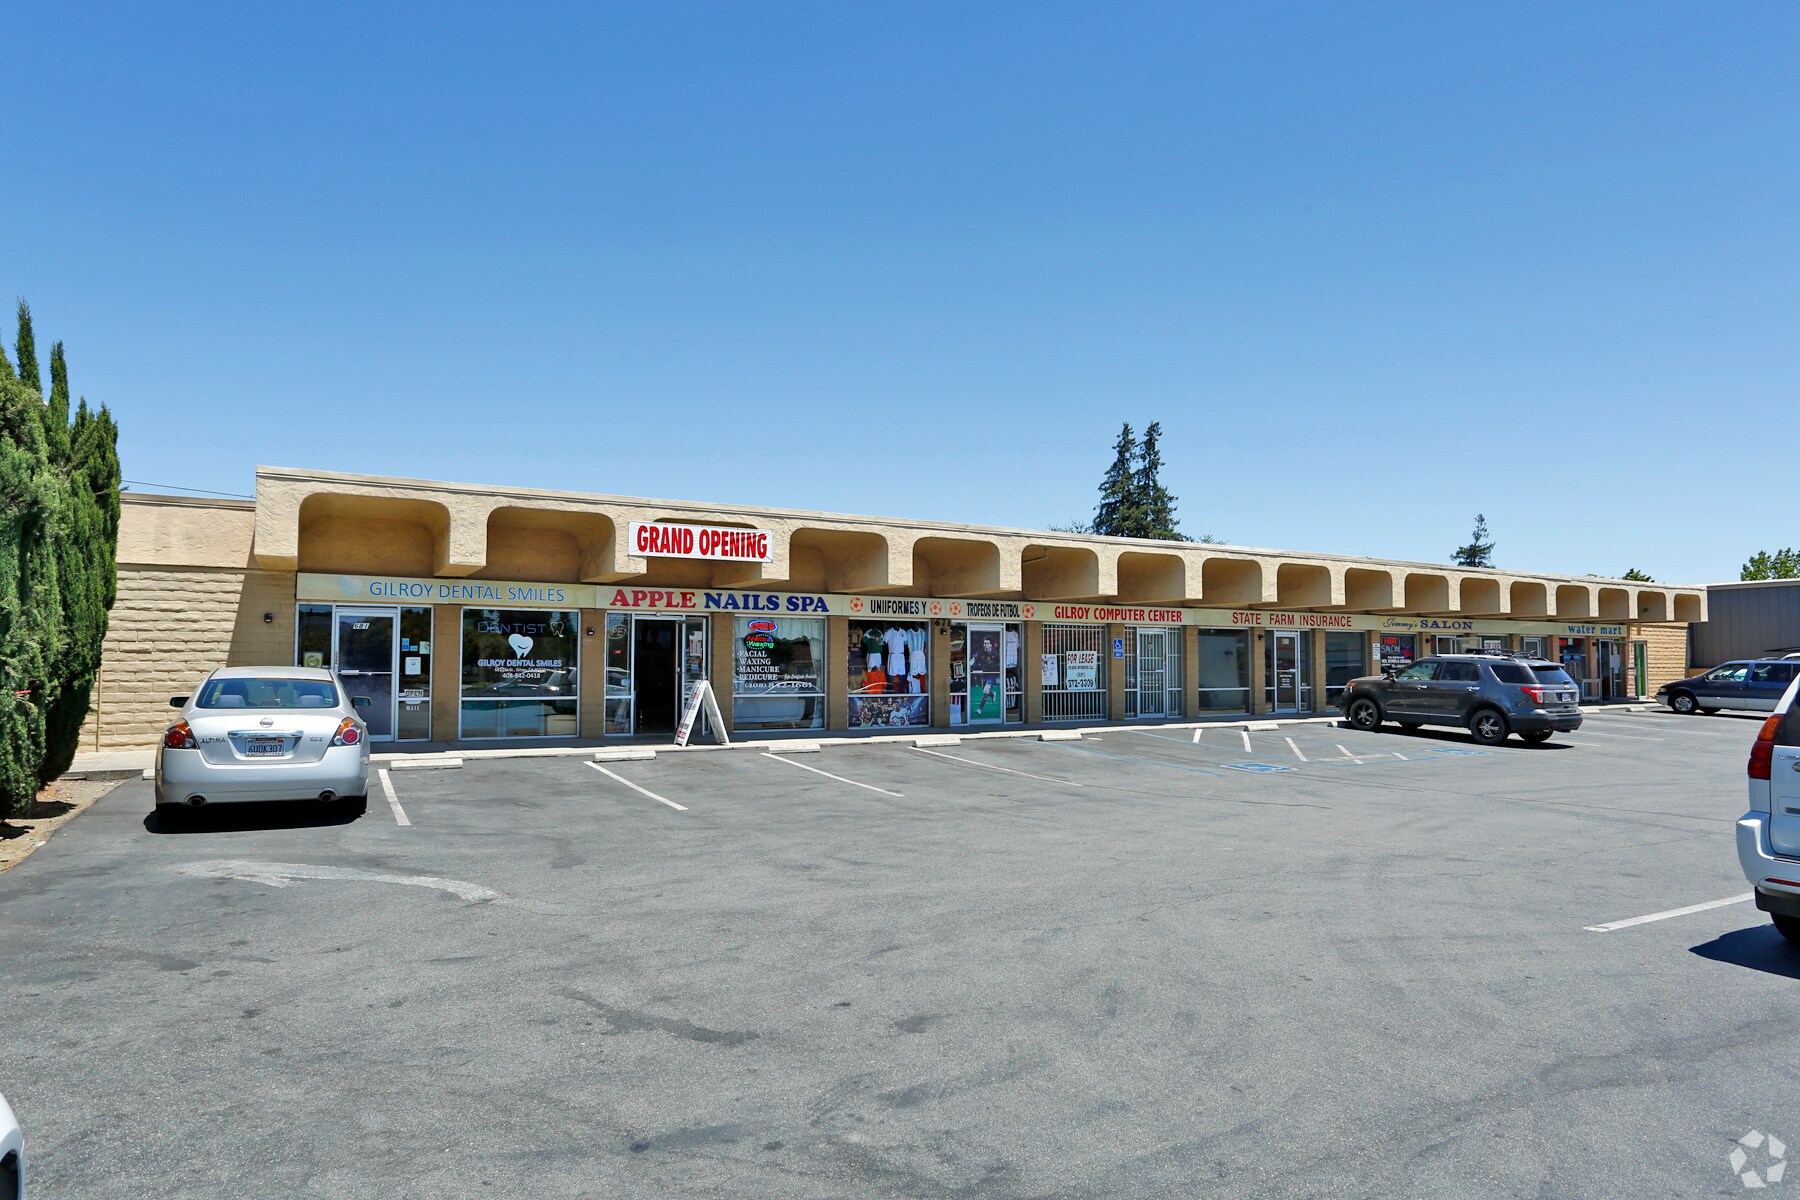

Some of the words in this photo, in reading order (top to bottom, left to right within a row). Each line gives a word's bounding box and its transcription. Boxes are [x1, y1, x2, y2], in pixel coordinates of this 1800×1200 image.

[637, 525, 694, 555] GRAND
[699, 529, 767, 559] OPENING
[369, 581, 434, 598] GILROY
[439, 584, 503, 600] DENTAL
[508, 586, 565, 602] SMILES
[610, 589, 697, 609] APPLE
[703, 592, 780, 611] NAILS
[786, 595, 830, 613] SPA
[870, 600, 920, 615] UNIIFORMES
[921, 601, 927, 615] Y
[966, 602, 992, 617] TROFEOS
[992, 603, 1000, 618] DE
[1000, 604, 1020, 618] FUTBOL
[1054, 606, 1091, 620] GILROY
[1093, 607, 1145, 621] COMPUTER
[1148, 609, 1183, 622] CENTER
[1232, 611, 1262, 625] STATE
[1269, 613, 1295, 626] FARM
[1299, 614, 1352, 627] INSURANCE
[1383, 617, 1418, 630] Jimmy's
[1420, 619, 1474, 630] SALON
[478, 621, 547, 634] DENTIST
[1567, 625, 1596, 634] water
[1600, 626, 1622, 635] mart
[748, 640, 774, 649] Waxing
[739, 650, 767, 658] FACIAL
[1067, 653, 1077, 663] FOR
[1078, 653, 1094, 664] LEASE
[478, 659, 505, 667] GILROY
[506, 659, 535, 667] DENTAL
[536, 659, 562, 667] SMILES
